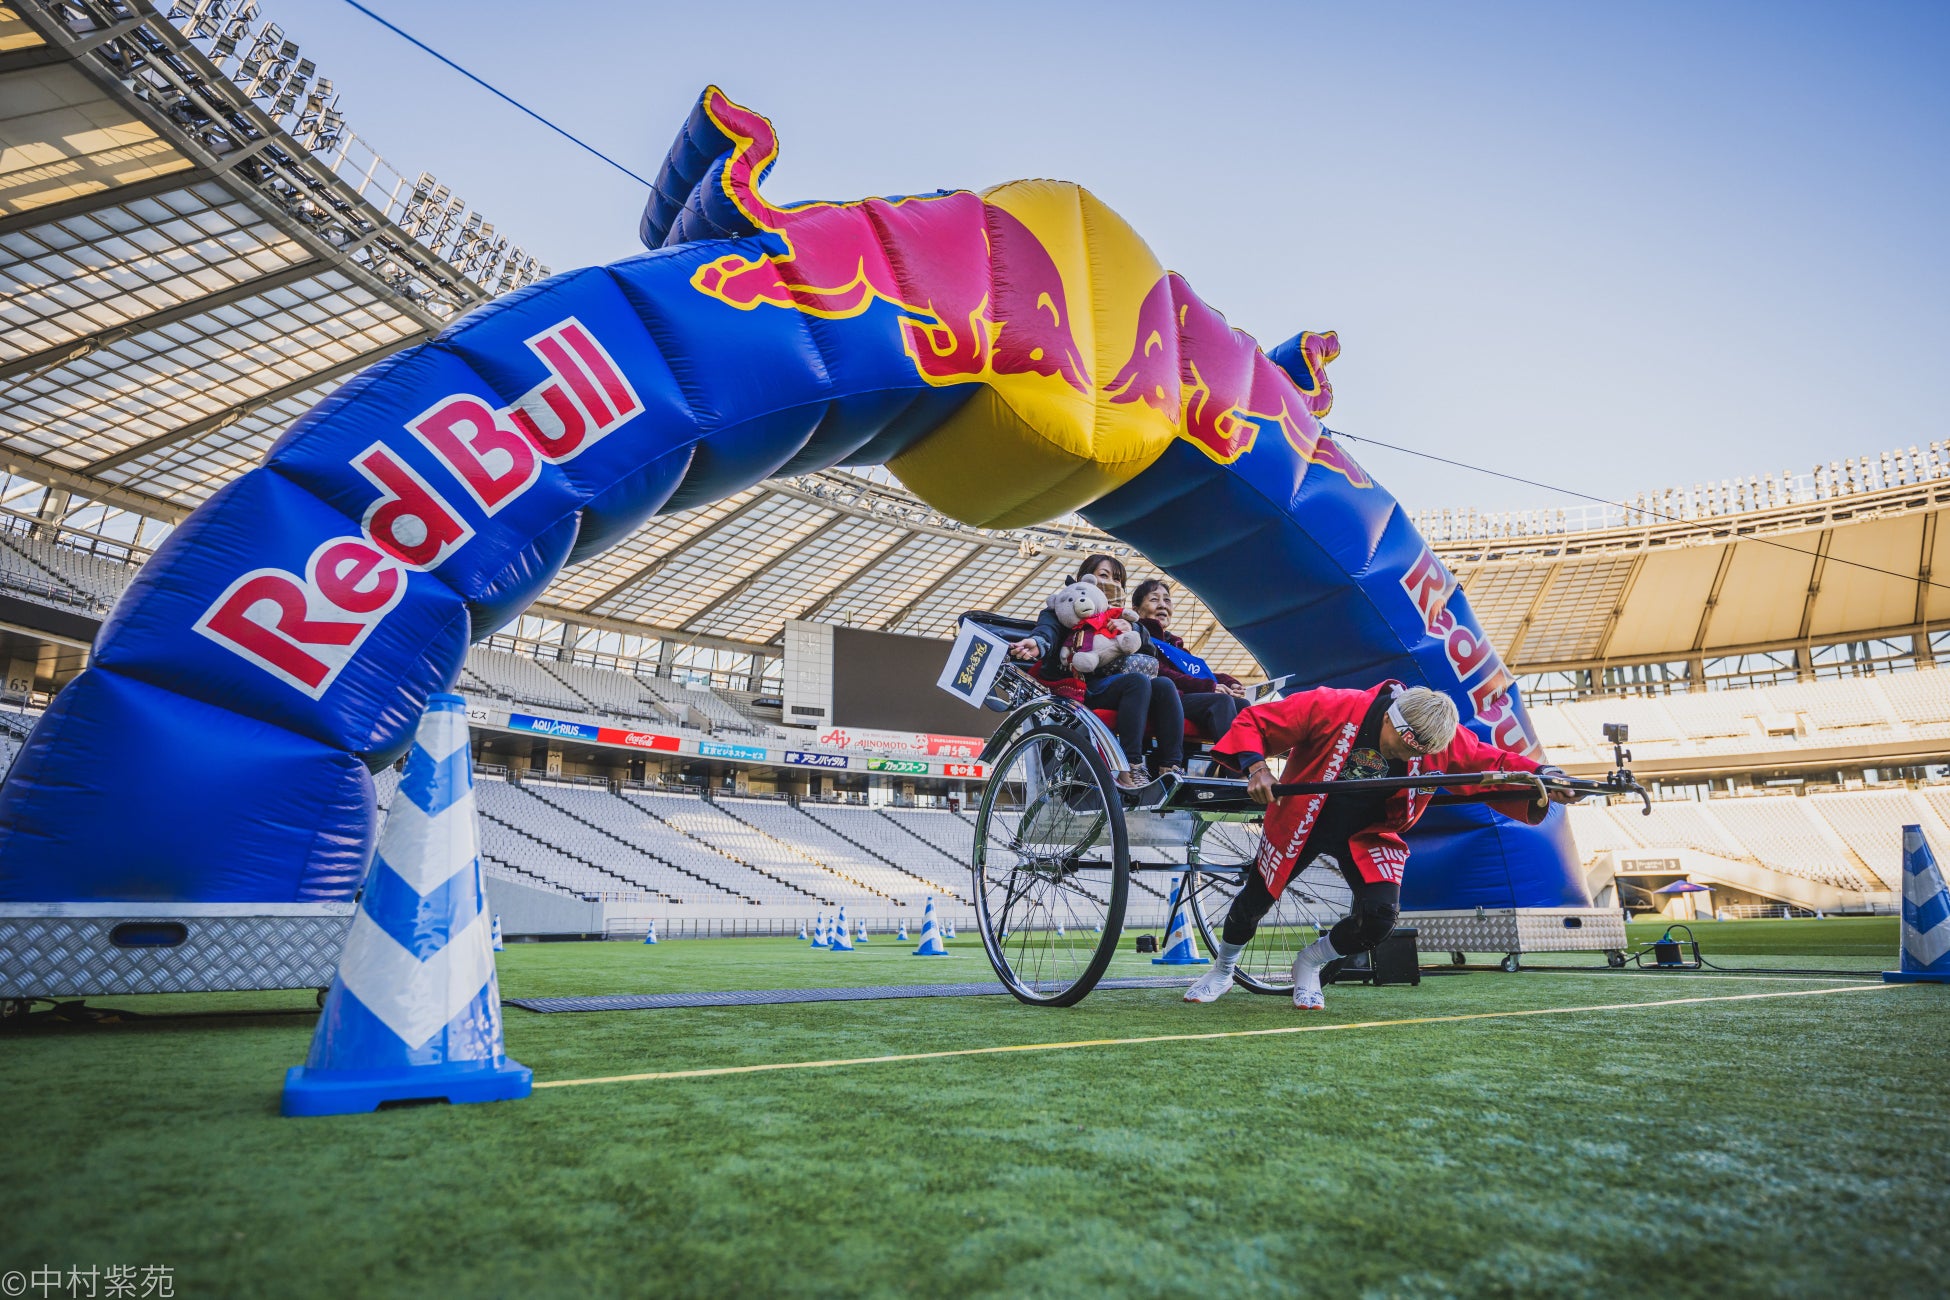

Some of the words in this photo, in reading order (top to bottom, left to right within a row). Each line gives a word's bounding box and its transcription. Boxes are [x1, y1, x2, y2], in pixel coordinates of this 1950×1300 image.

[192, 440, 476, 701] Red
[403, 315, 646, 518] Bull
[10, 678, 28, 691] 65
[531, 719, 580, 736] AQUARIUS
[625, 732, 656, 747] Coca-Cola
[854, 739, 907, 750] AJINOMOTO
[702, 746, 764, 759] 東京ビジネスサービス
[801, 754, 846, 767] アミノバイタル
[884, 761, 927, 773] カップスープ
[549, 764, 559, 773] 61
